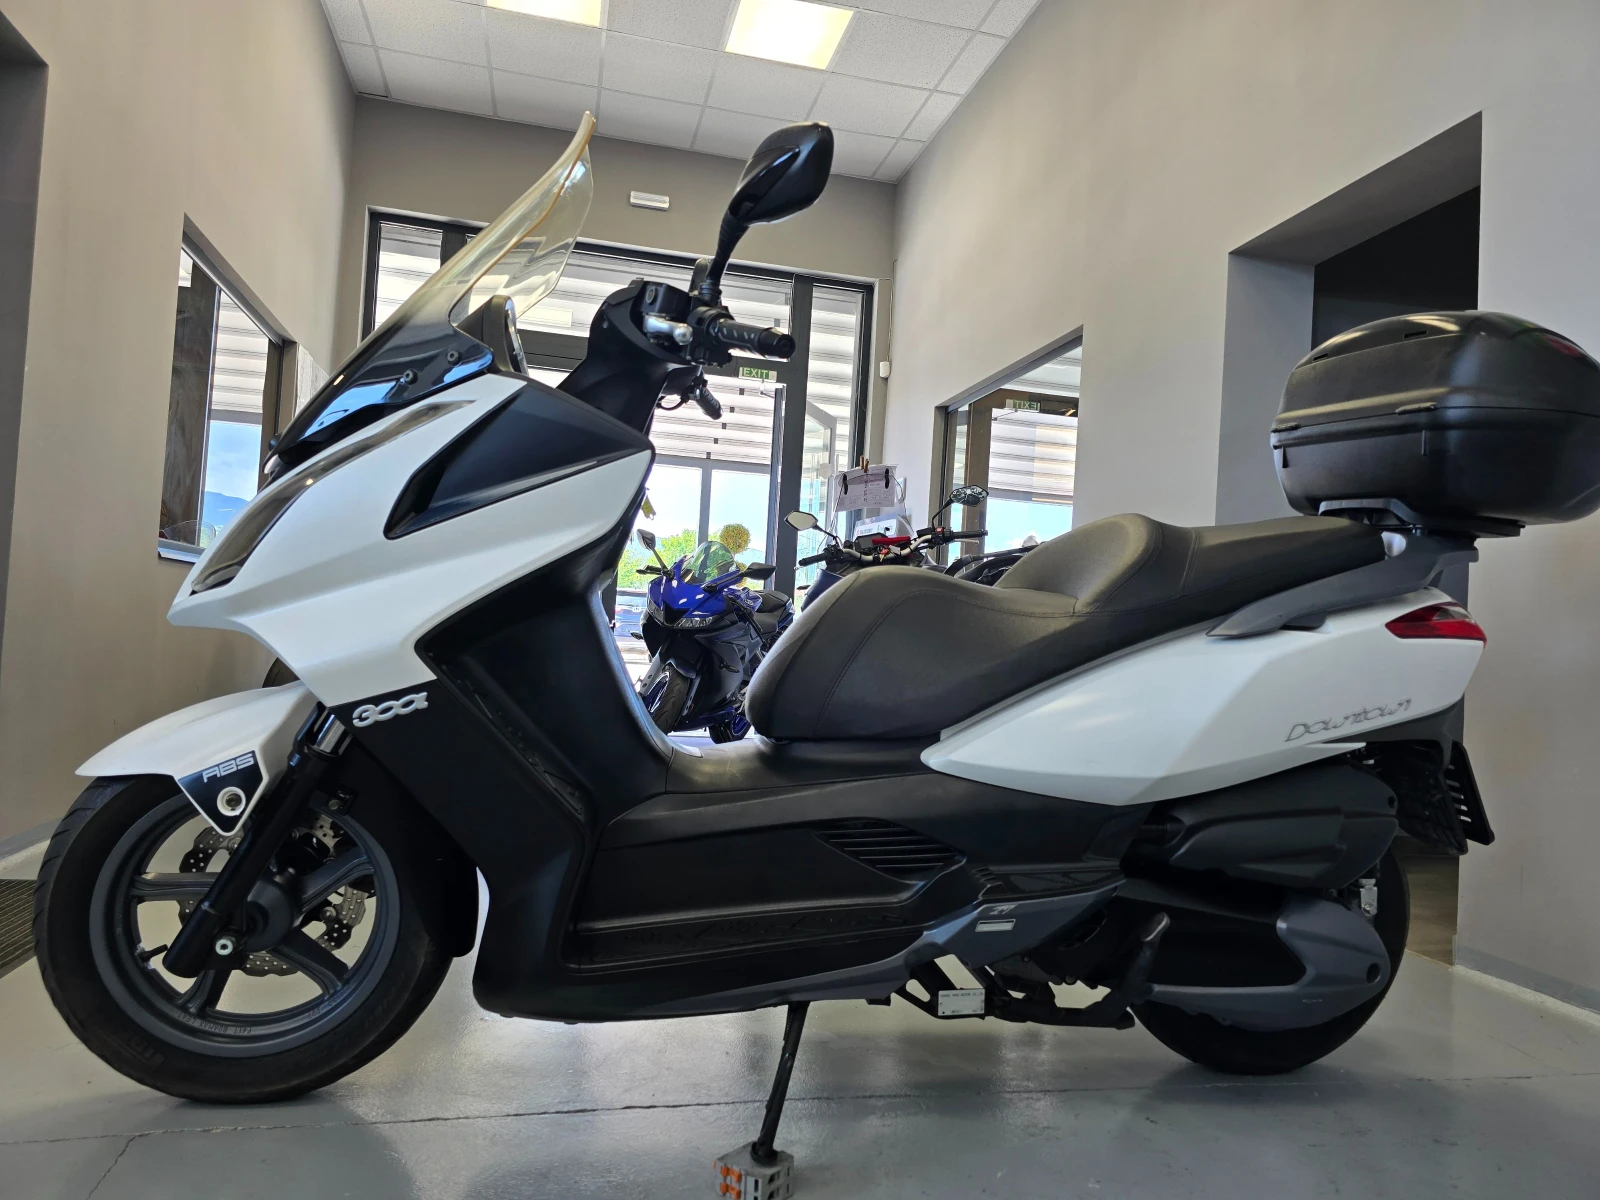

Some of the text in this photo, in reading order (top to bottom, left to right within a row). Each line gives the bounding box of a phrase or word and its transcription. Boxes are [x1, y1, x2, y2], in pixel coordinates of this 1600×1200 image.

[743, 367, 768, 378] EXIT
[1284, 696, 1412, 742] Downtown
[202, 752, 255, 783] ABS
